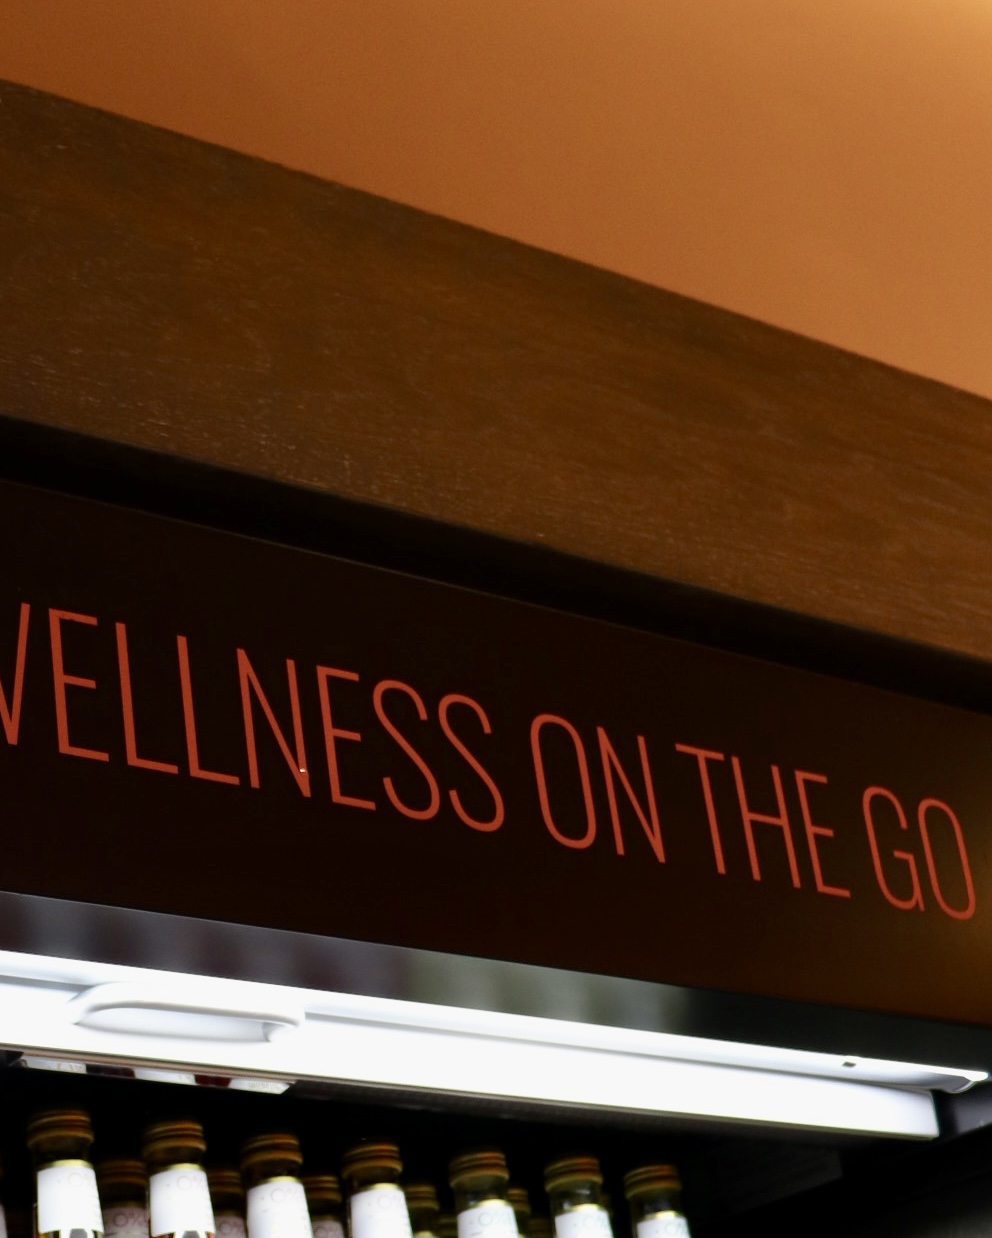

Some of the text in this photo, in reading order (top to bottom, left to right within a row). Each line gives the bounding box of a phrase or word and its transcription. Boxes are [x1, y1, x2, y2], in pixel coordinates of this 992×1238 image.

[531, 714, 665, 862] ON
[676, 744, 850, 897] THE
[863, 787, 976, 920] GO
